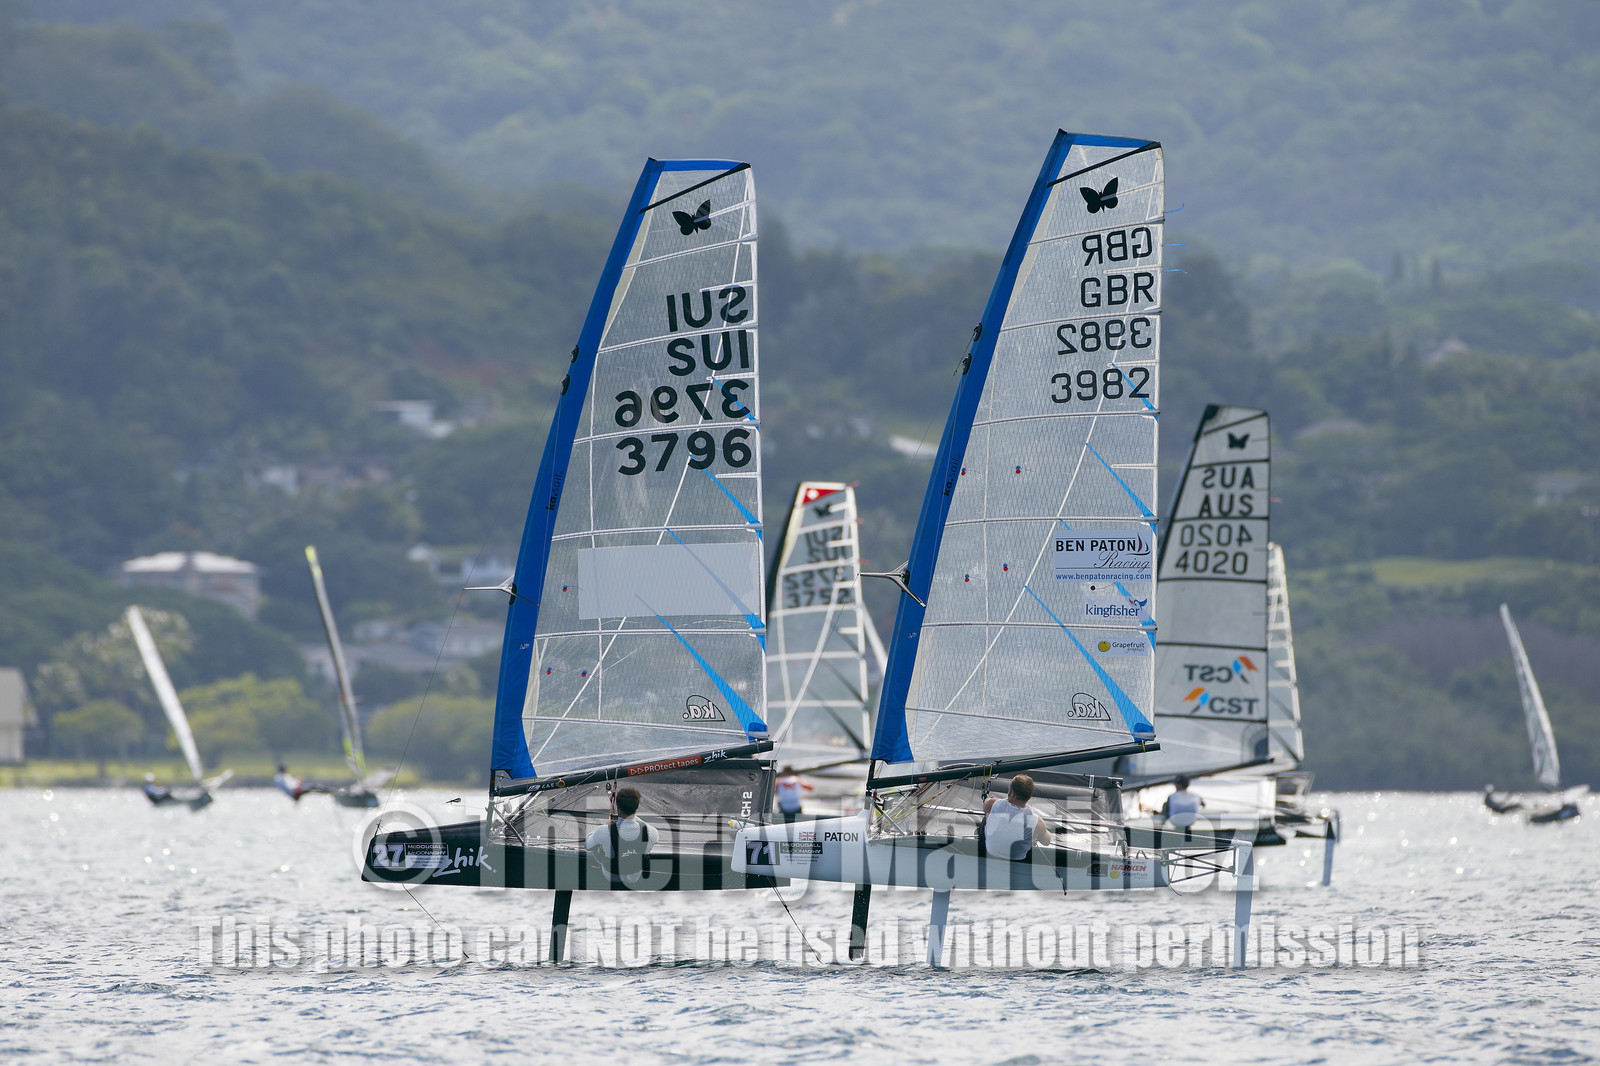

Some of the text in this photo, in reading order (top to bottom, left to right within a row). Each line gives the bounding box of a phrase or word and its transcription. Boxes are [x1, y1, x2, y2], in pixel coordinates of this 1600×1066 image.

[1081, 272, 1154, 307] GBR
[667, 330, 749, 376] SUI
[1051, 367, 1150, 403] 3982
[616, 428, 752, 475] 3796
[1199, 494, 1254, 517] AUS
[1056, 539, 1136, 552] BEN PATON
[1094, 549, 1151, 573] Racing
[1175, 550, 1248, 575] 4020
[1055, 572, 1152, 581] www.benpatonracing.com
[1085, 604, 1139, 618] kingfisher
[1208, 697, 1259, 714] CST
[644, 758, 699, 773] PROtect tapes
[741, 791, 753, 820] CH 2
[824, 832, 859, 842] PATON
[373, 844, 404, 867] 27
[747, 841, 777, 865] 71
